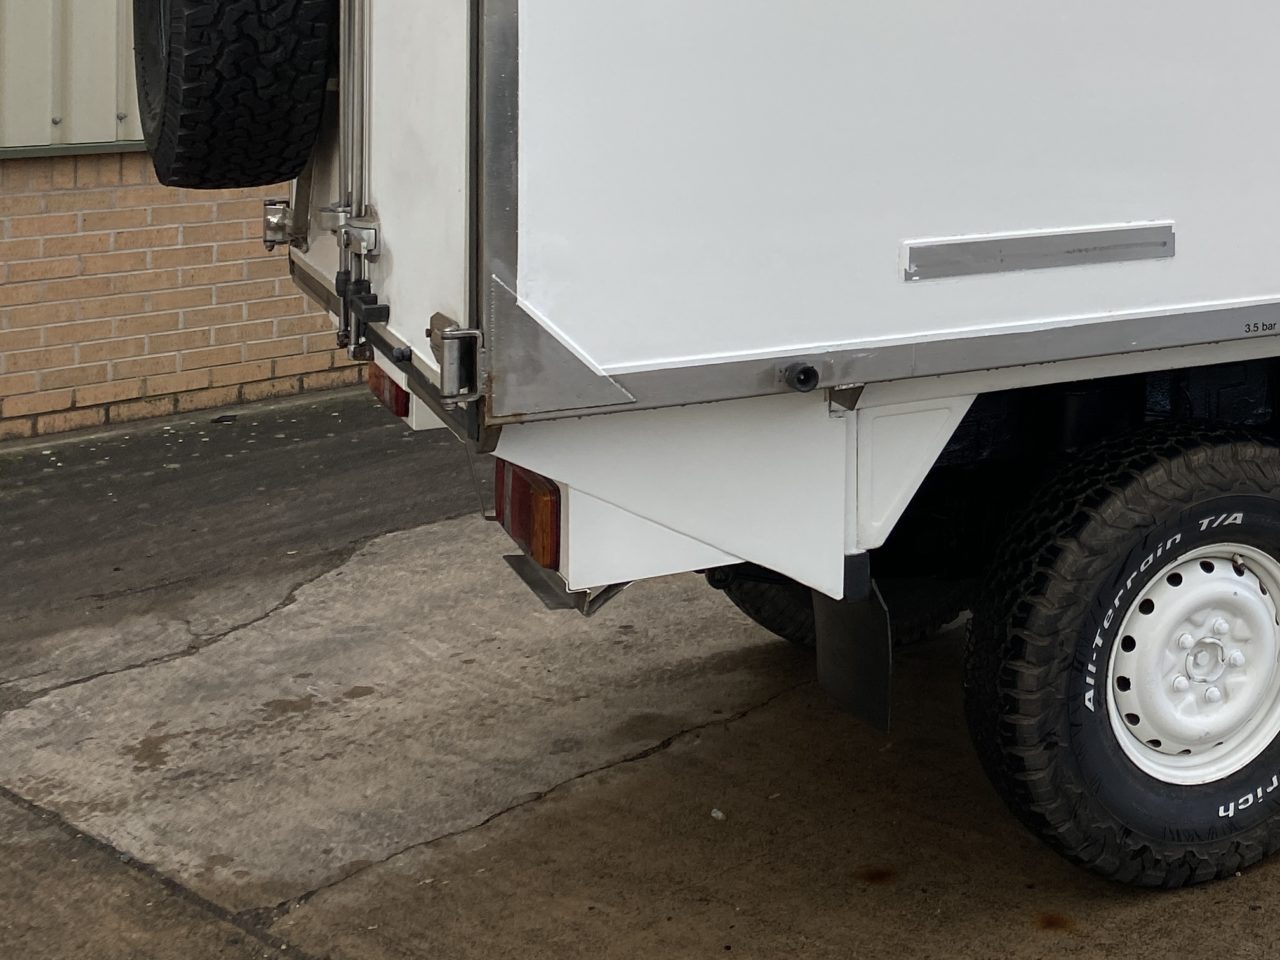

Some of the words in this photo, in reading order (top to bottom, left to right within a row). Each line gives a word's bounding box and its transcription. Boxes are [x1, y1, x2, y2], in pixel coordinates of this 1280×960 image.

[1244, 323, 1260, 334] 3.5
[1261, 321, 1278, 332] bar
[1084, 532, 1182, 713] All-Terrain
[1198, 512, 1245, 533] T/A
